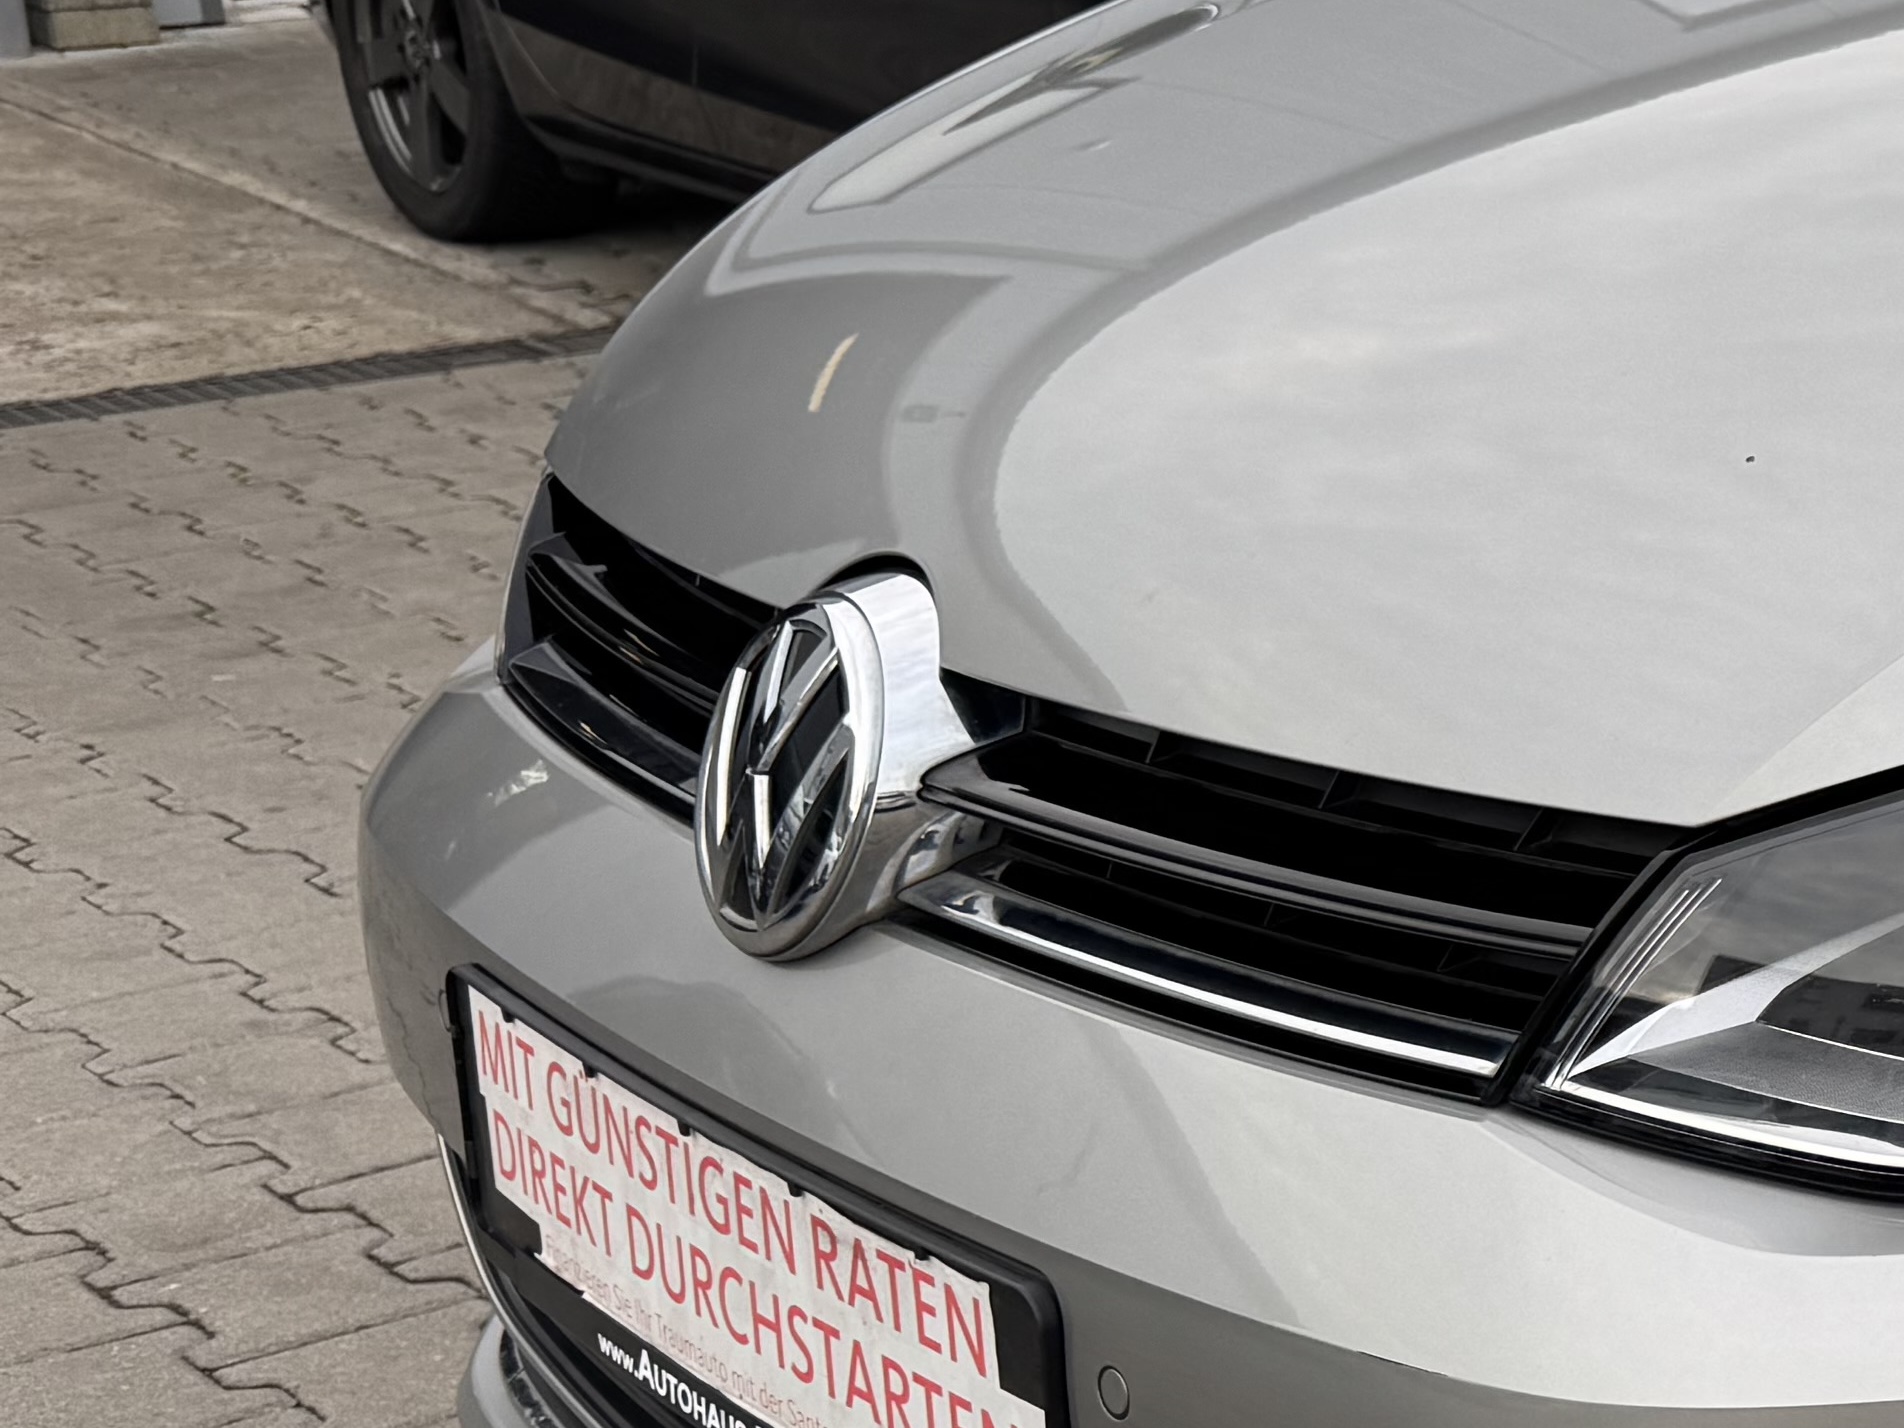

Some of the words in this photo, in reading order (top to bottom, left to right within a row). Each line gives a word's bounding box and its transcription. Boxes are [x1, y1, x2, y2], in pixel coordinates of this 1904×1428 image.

[478, 1009, 535, 1111] MIT
[546, 1060, 797, 1276] GÜNSTIGEN
[810, 1212, 988, 1378] RATEN
[493, 1107, 613, 1258] DIREKT
[731, 1370, 757, 1402] mit
[759, 1382, 783, 1417] der
